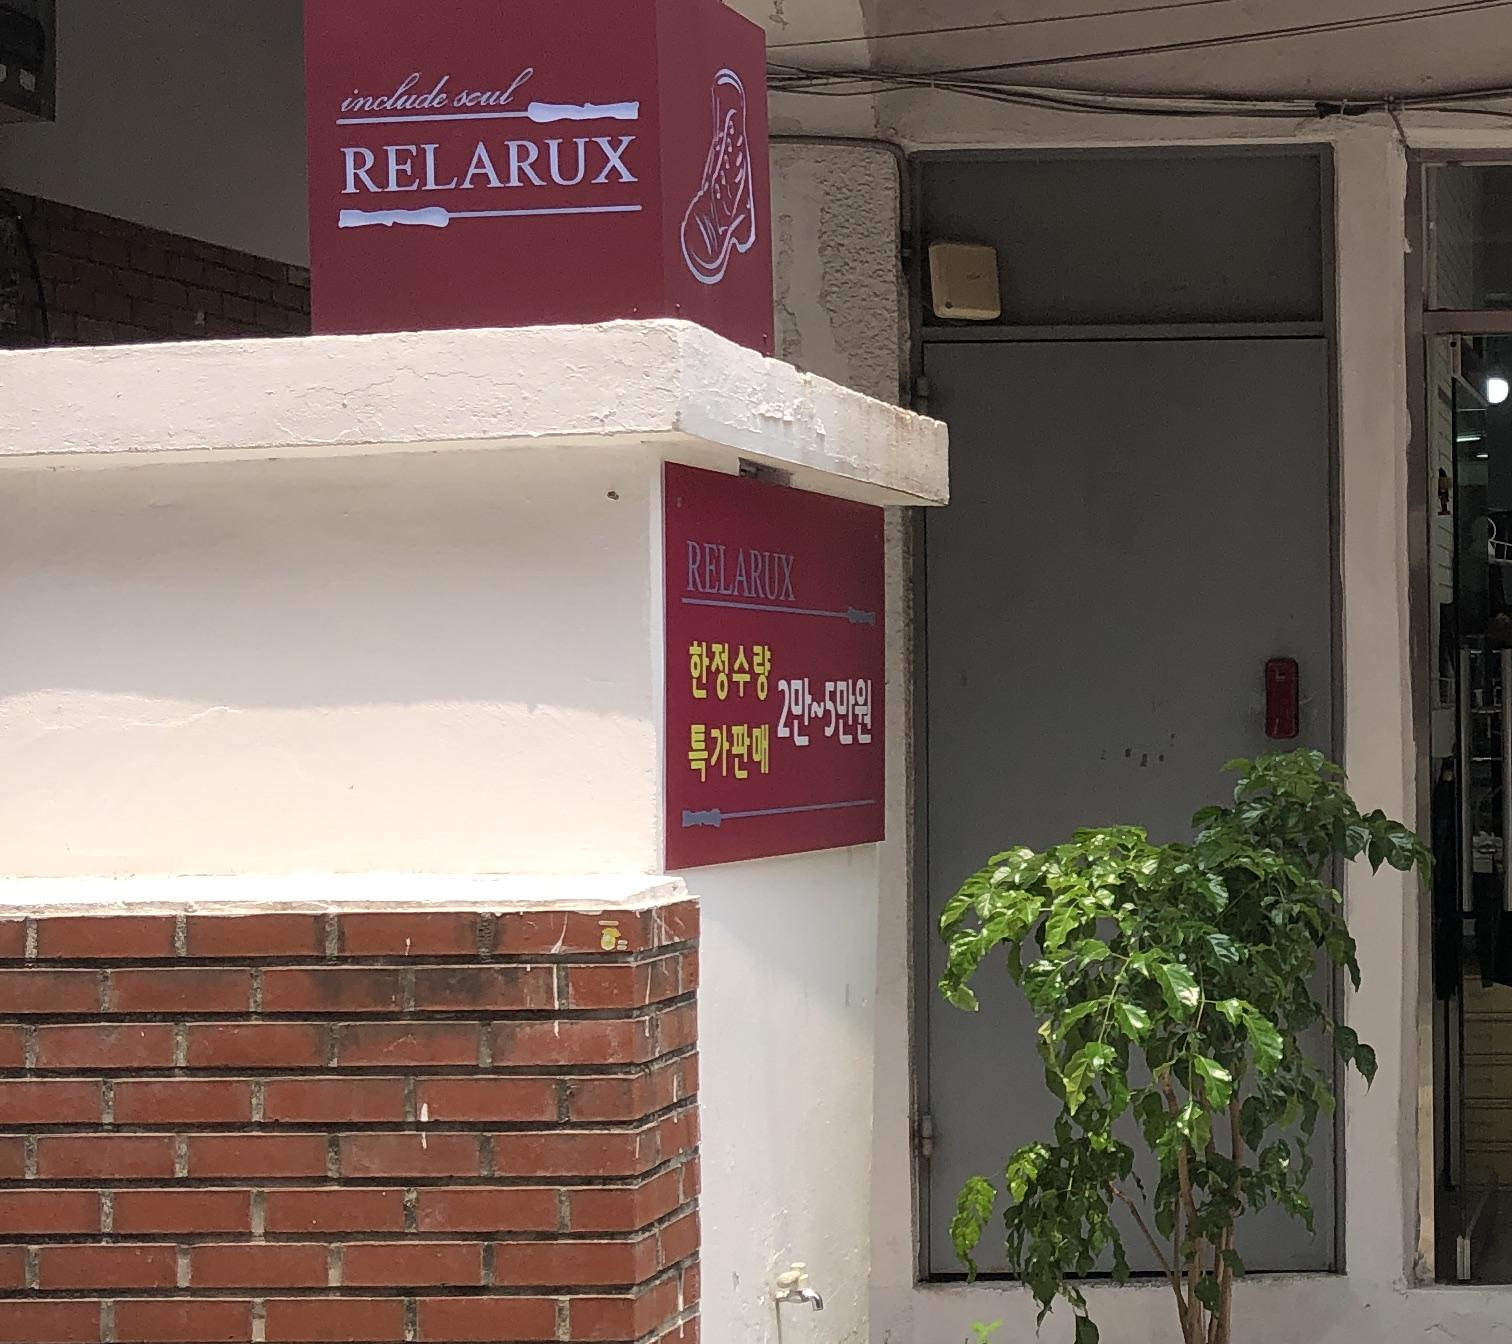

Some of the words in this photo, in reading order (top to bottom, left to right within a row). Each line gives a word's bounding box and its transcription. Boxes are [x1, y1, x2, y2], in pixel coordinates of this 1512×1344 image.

[340, 72, 450, 112] include
[453, 67, 534, 106] soul
[339, 135, 638, 195] RELARUX
[687, 540, 796, 601] RELARUX
[688, 640, 772, 701] 한정수량
[776, 676, 873, 747] 2만~5만원
[688, 723, 769, 783] 특가판매
